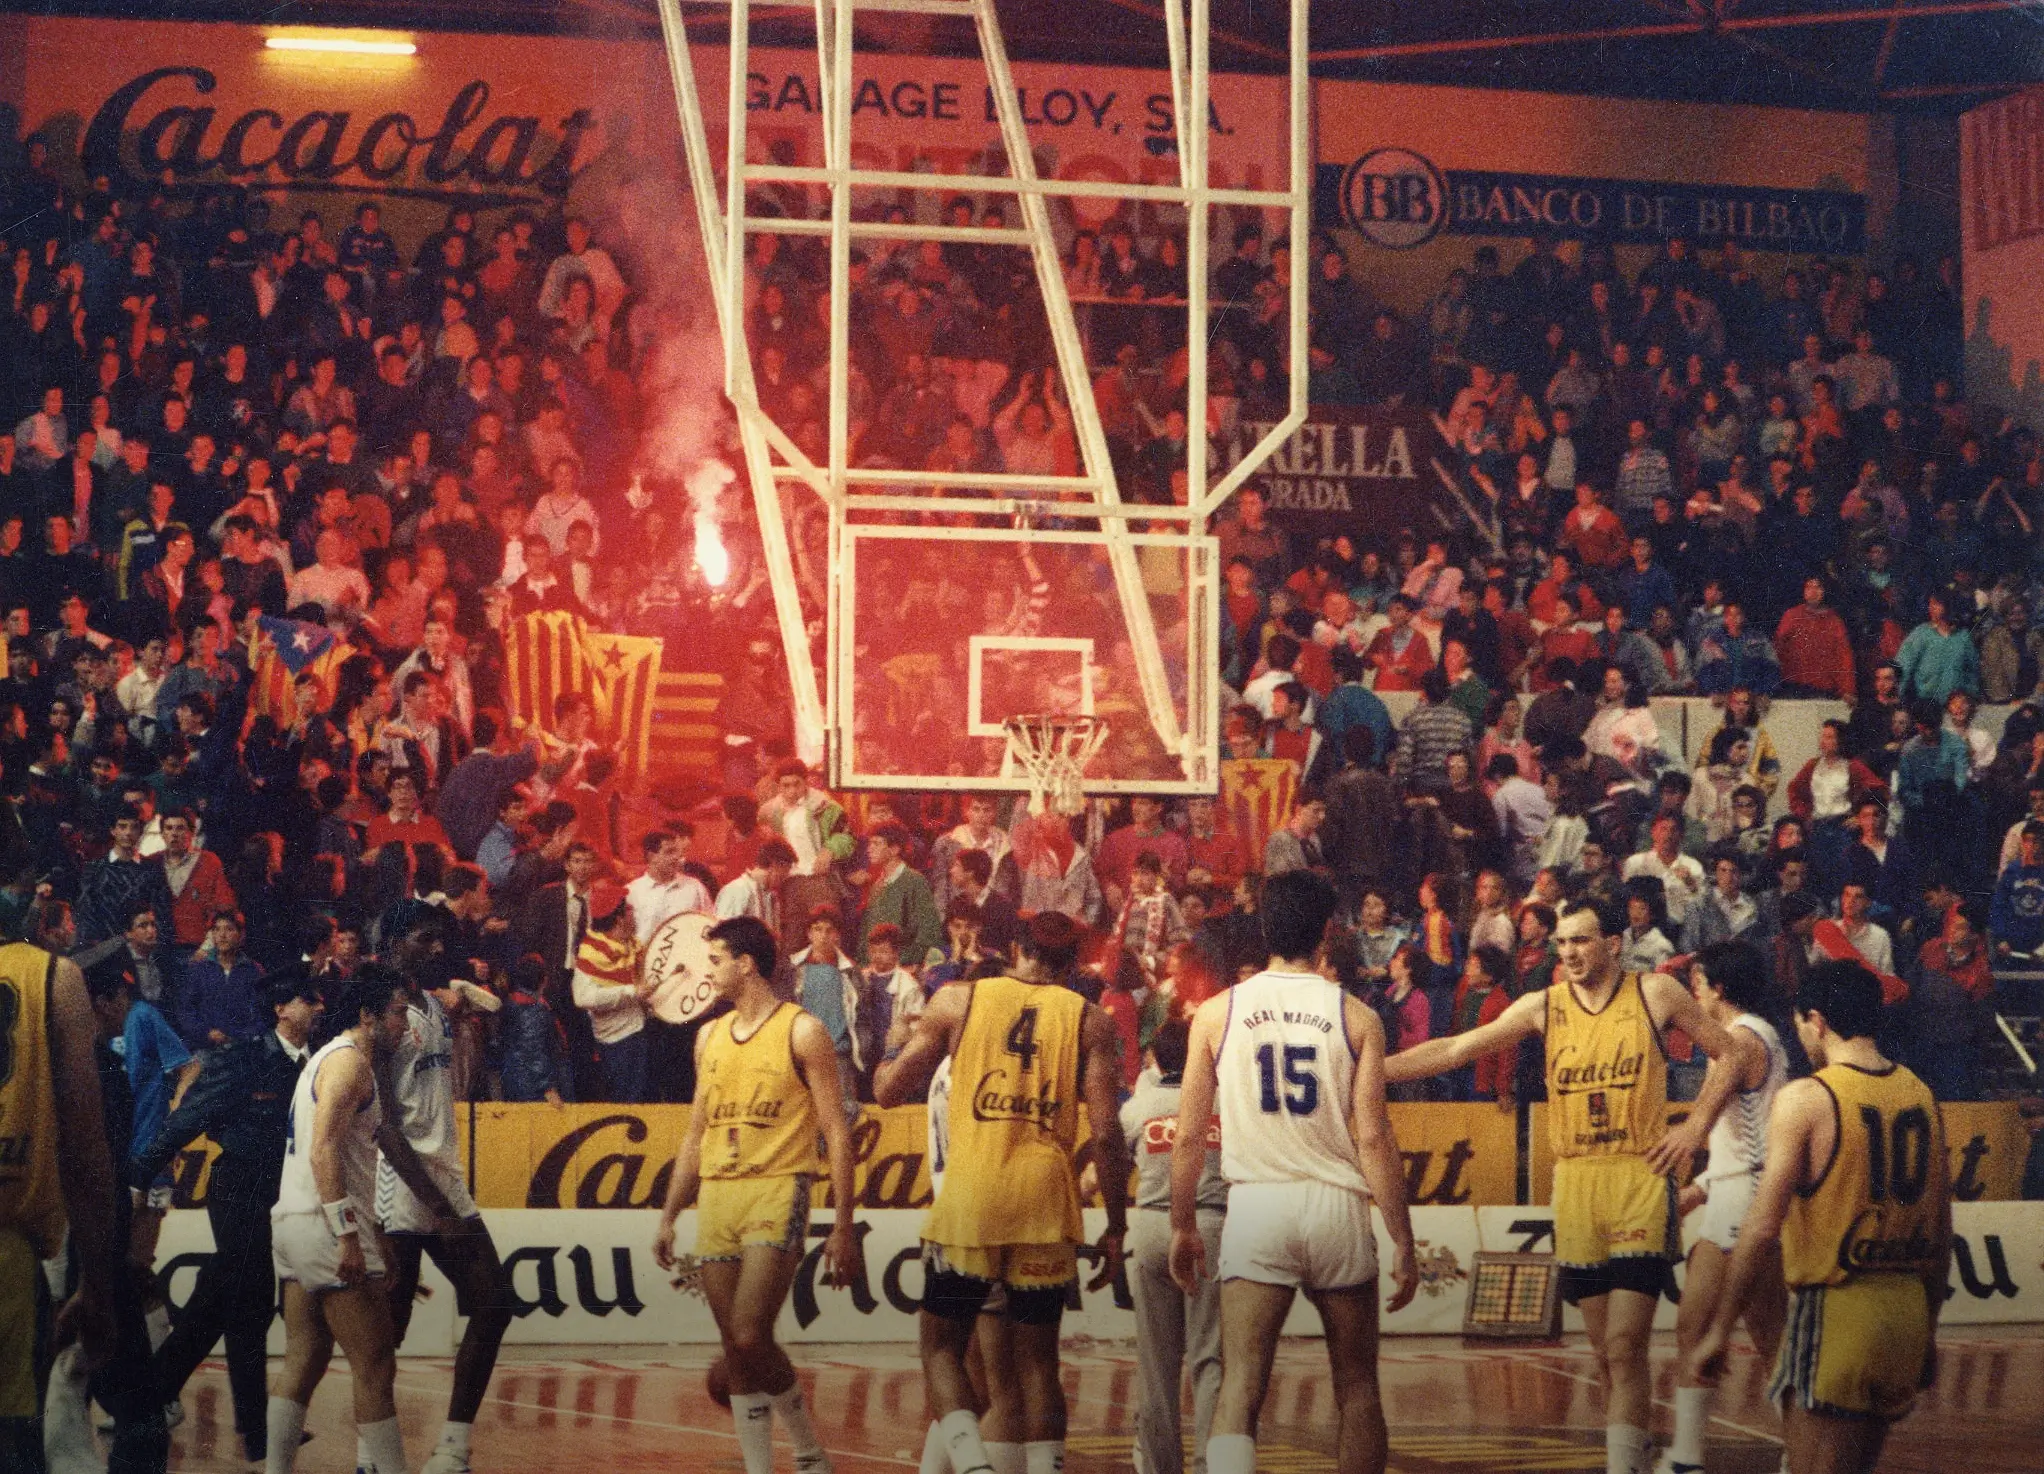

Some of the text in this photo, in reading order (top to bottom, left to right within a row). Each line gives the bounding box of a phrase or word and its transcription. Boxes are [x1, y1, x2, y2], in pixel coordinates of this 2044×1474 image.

[745, 70, 962, 120] GAAGE
[82, 65, 600, 203] Cacaolat
[1362, 171, 1434, 225] BB
[1458, 185, 1601, 228] BANCO
[1700, 200, 1849, 245] BILBAO
[1259, 477, 1353, 510] RADA
[1005, 1005, 1044, 1074] 4
[1243, 1009, 1333, 1034] REAL MADRID
[1255, 1043, 1320, 1115] 15
[1858, 1103, 1932, 1206] 10
